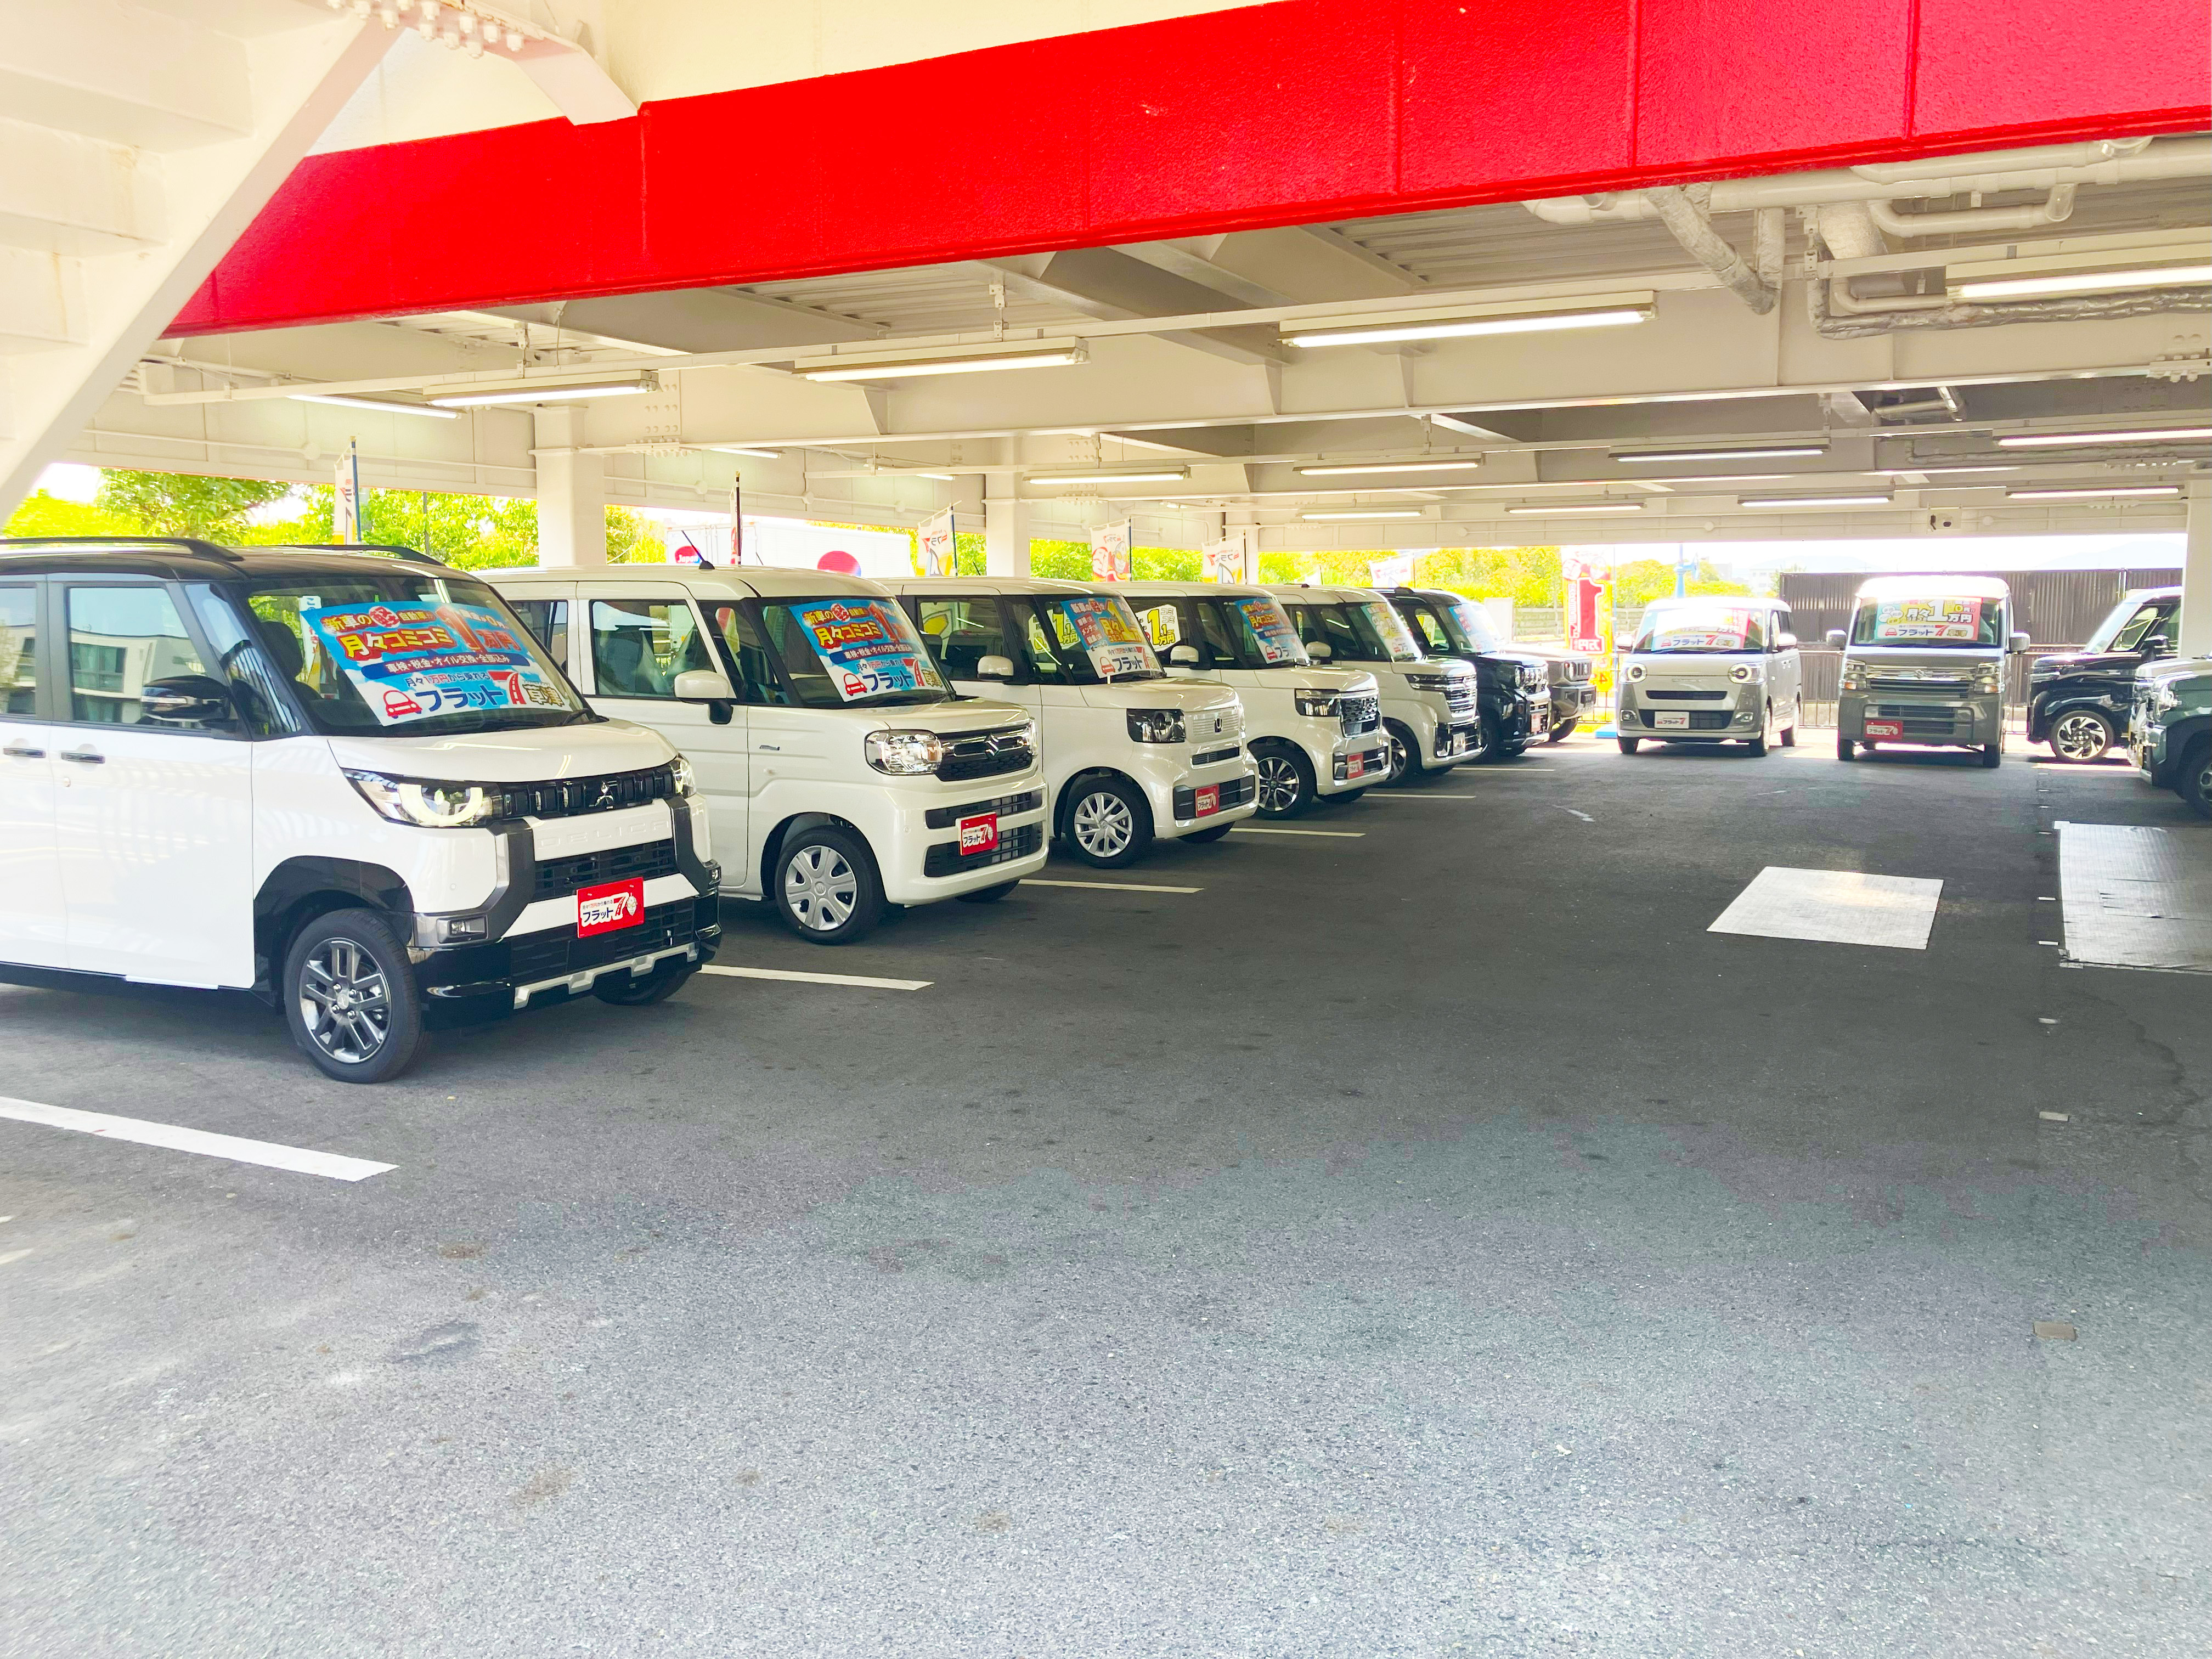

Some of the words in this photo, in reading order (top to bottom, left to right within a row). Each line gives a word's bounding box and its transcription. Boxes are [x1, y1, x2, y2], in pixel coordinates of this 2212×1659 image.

[340, 628, 454, 658] 月々コミコミ
